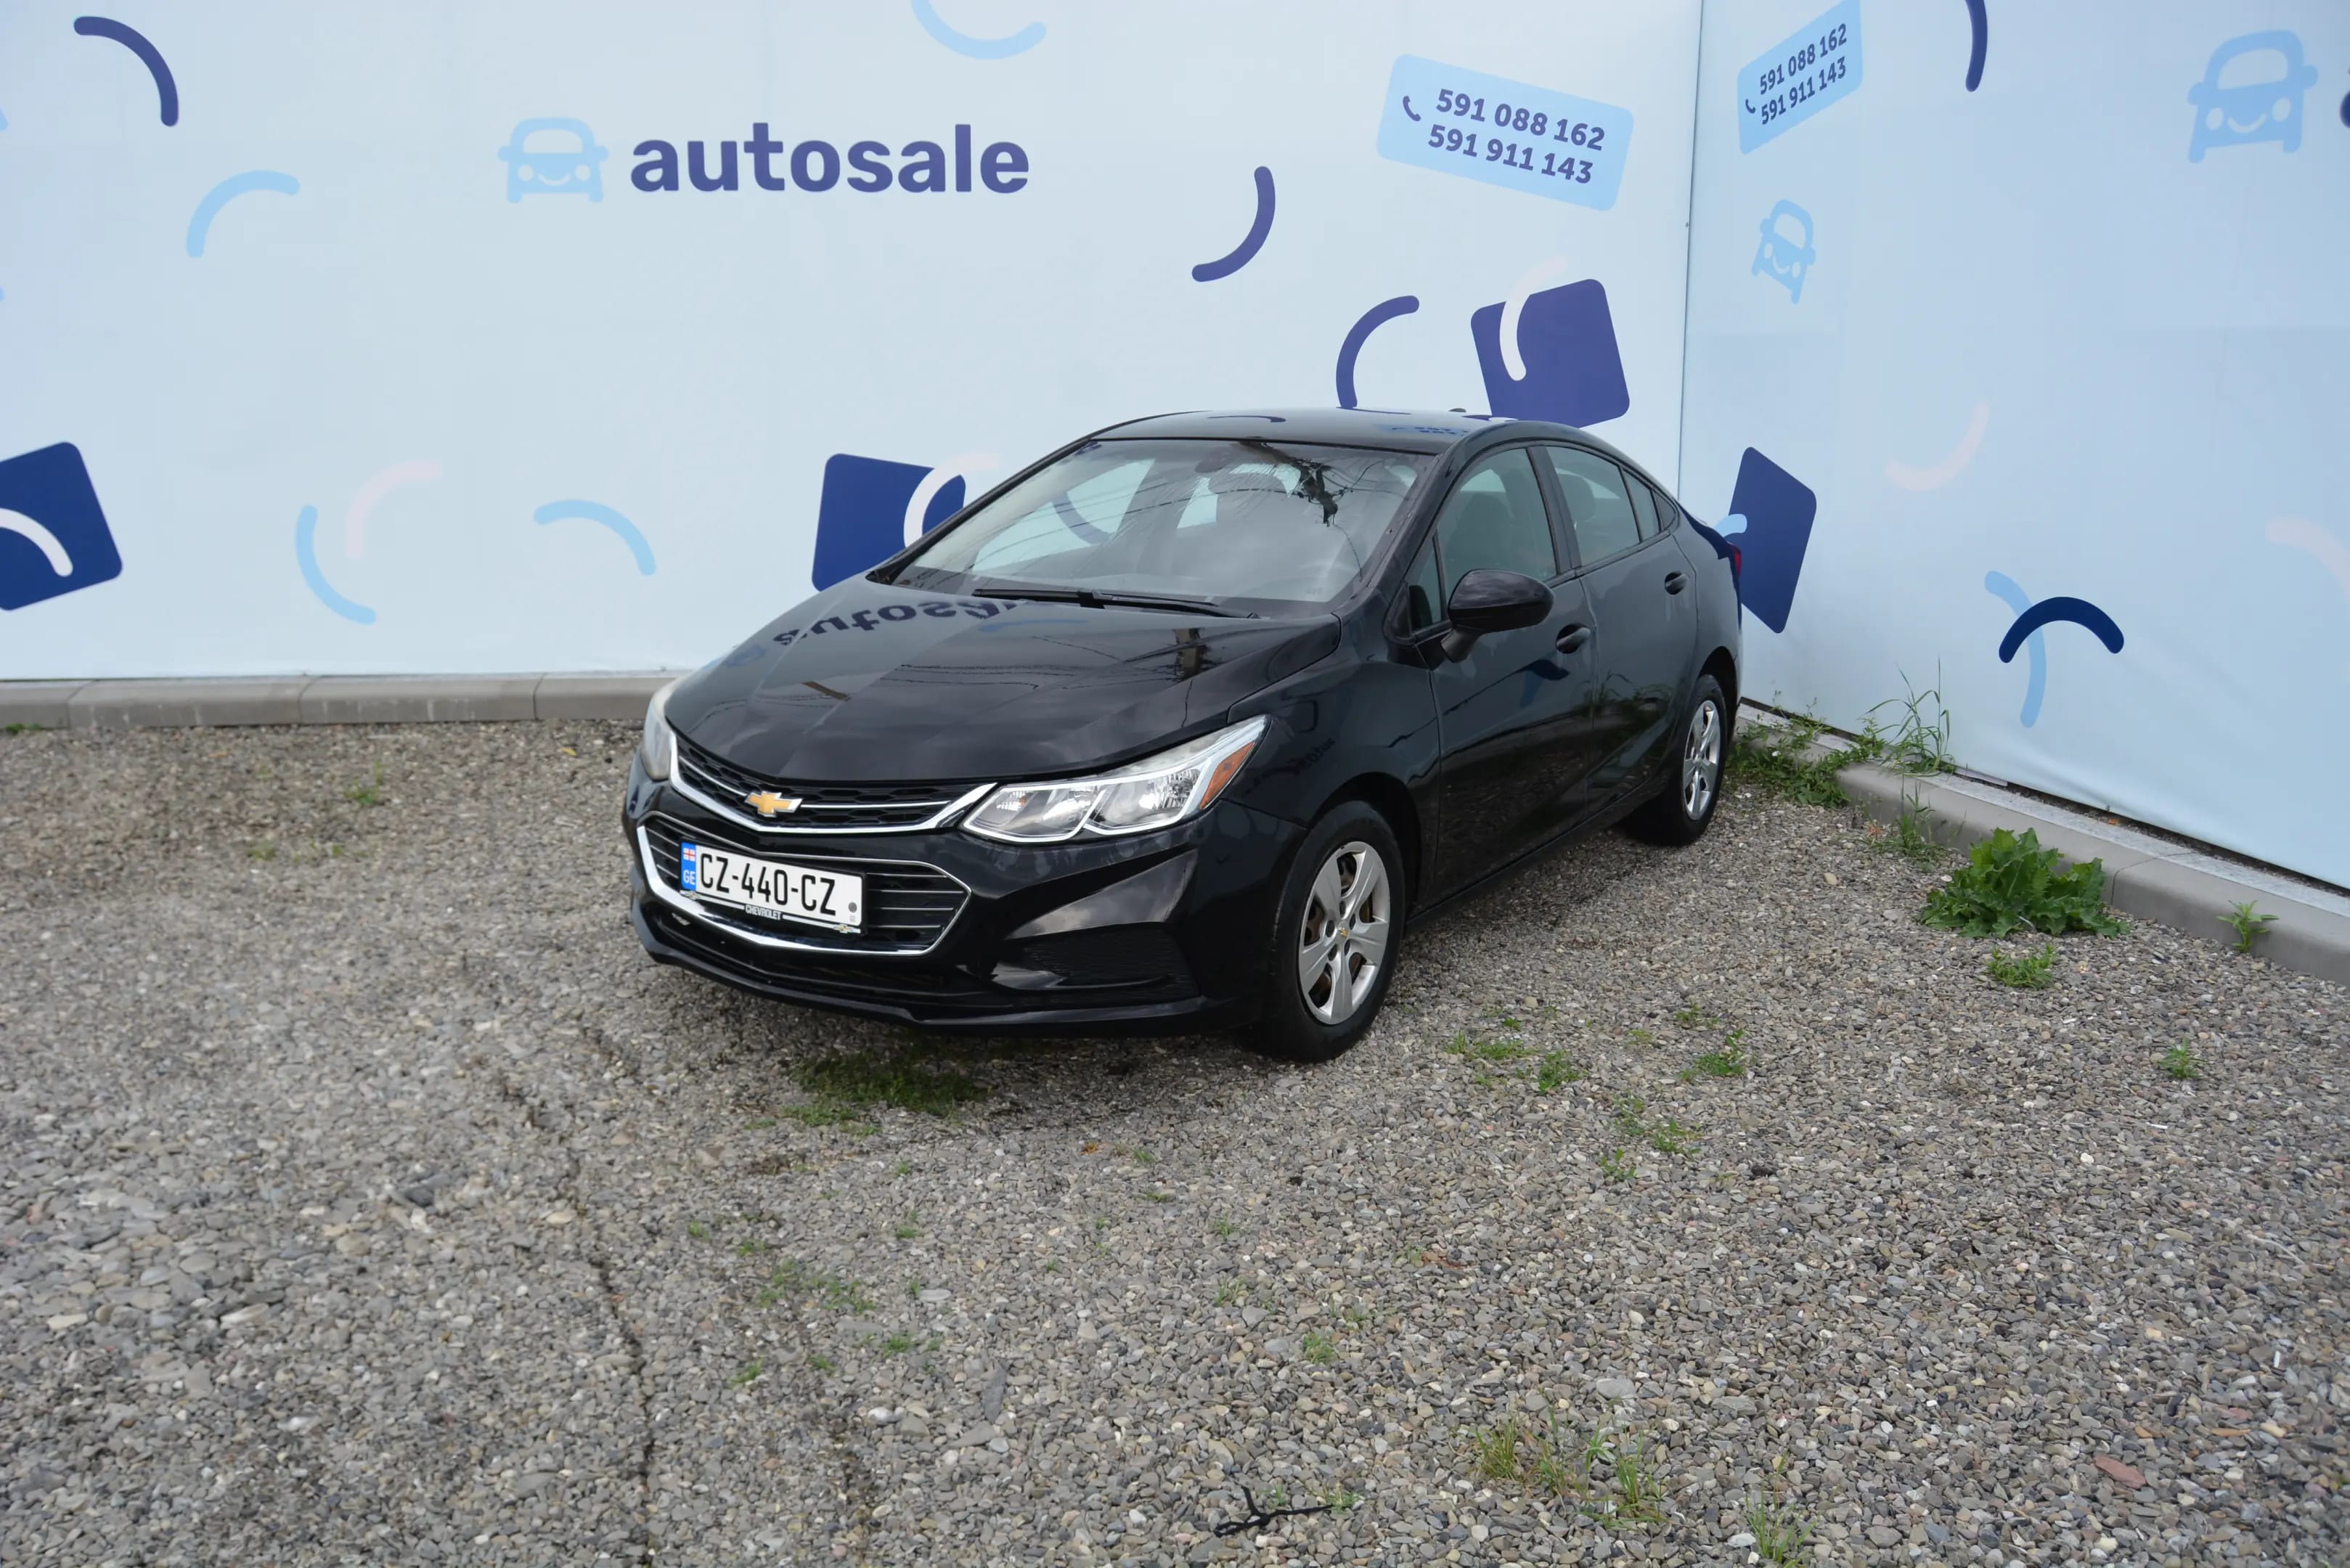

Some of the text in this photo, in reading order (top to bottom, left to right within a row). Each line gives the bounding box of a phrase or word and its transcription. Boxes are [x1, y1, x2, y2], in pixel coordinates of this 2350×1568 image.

[1760, 23, 1847, 94] 591 088 162
[1436, 89, 1605, 151] 591 088 162
[1761, 56, 1846, 125] 591 911 143
[630, 122, 1029, 194] autosale
[1428, 124, 1594, 184] 591 911 143
[683, 870, 696, 886] GE
[701, 852, 836, 916] CZ-440-CZ
[745, 904, 782, 920] CHEVROLET
